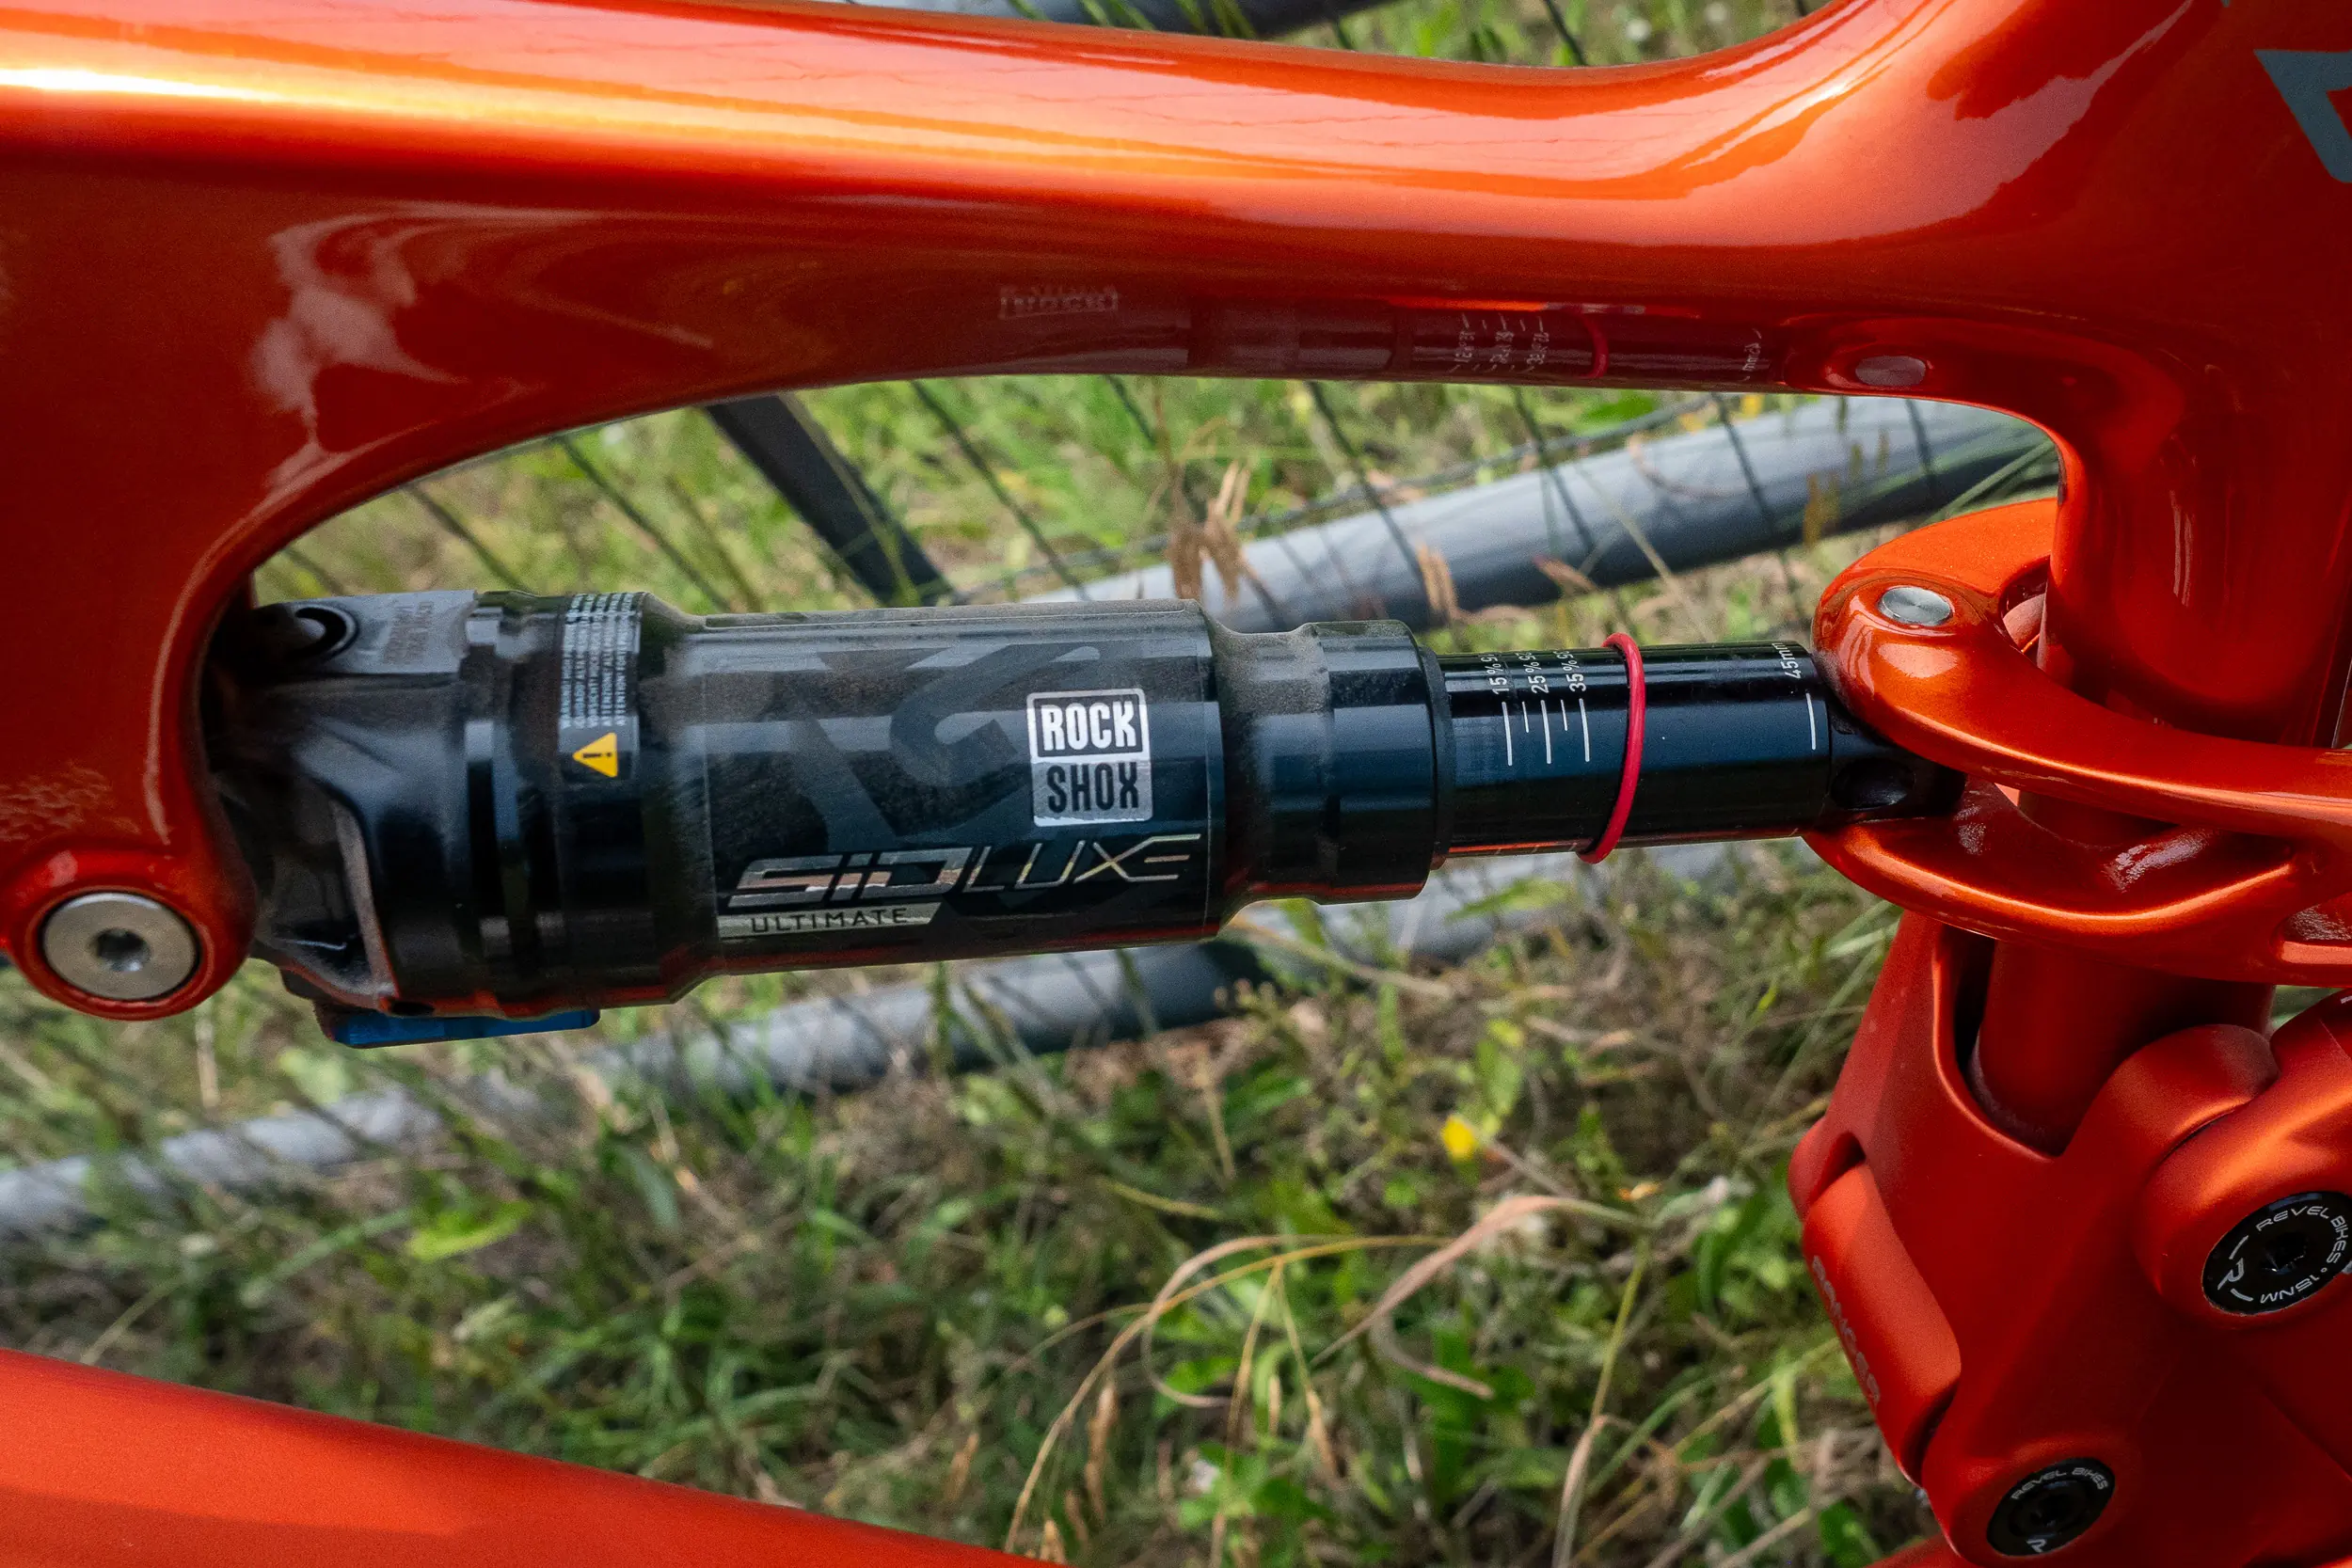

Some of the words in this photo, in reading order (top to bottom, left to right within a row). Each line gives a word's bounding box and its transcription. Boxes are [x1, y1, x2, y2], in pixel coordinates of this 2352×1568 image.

[1772, 642, 1802, 679] 45mm
[1041, 701, 1137, 752] ROCK
[1046, 761, 1139, 814] SHOX
[752, 907, 909, 933] ULTIMATE
[2255, 1206, 2329, 1232] REVEL
[2326, 1215, 2349, 1264] BIKES
[2010, 1469, 2067, 1500] REVEL
[2072, 1466, 2109, 1491] BIKES
